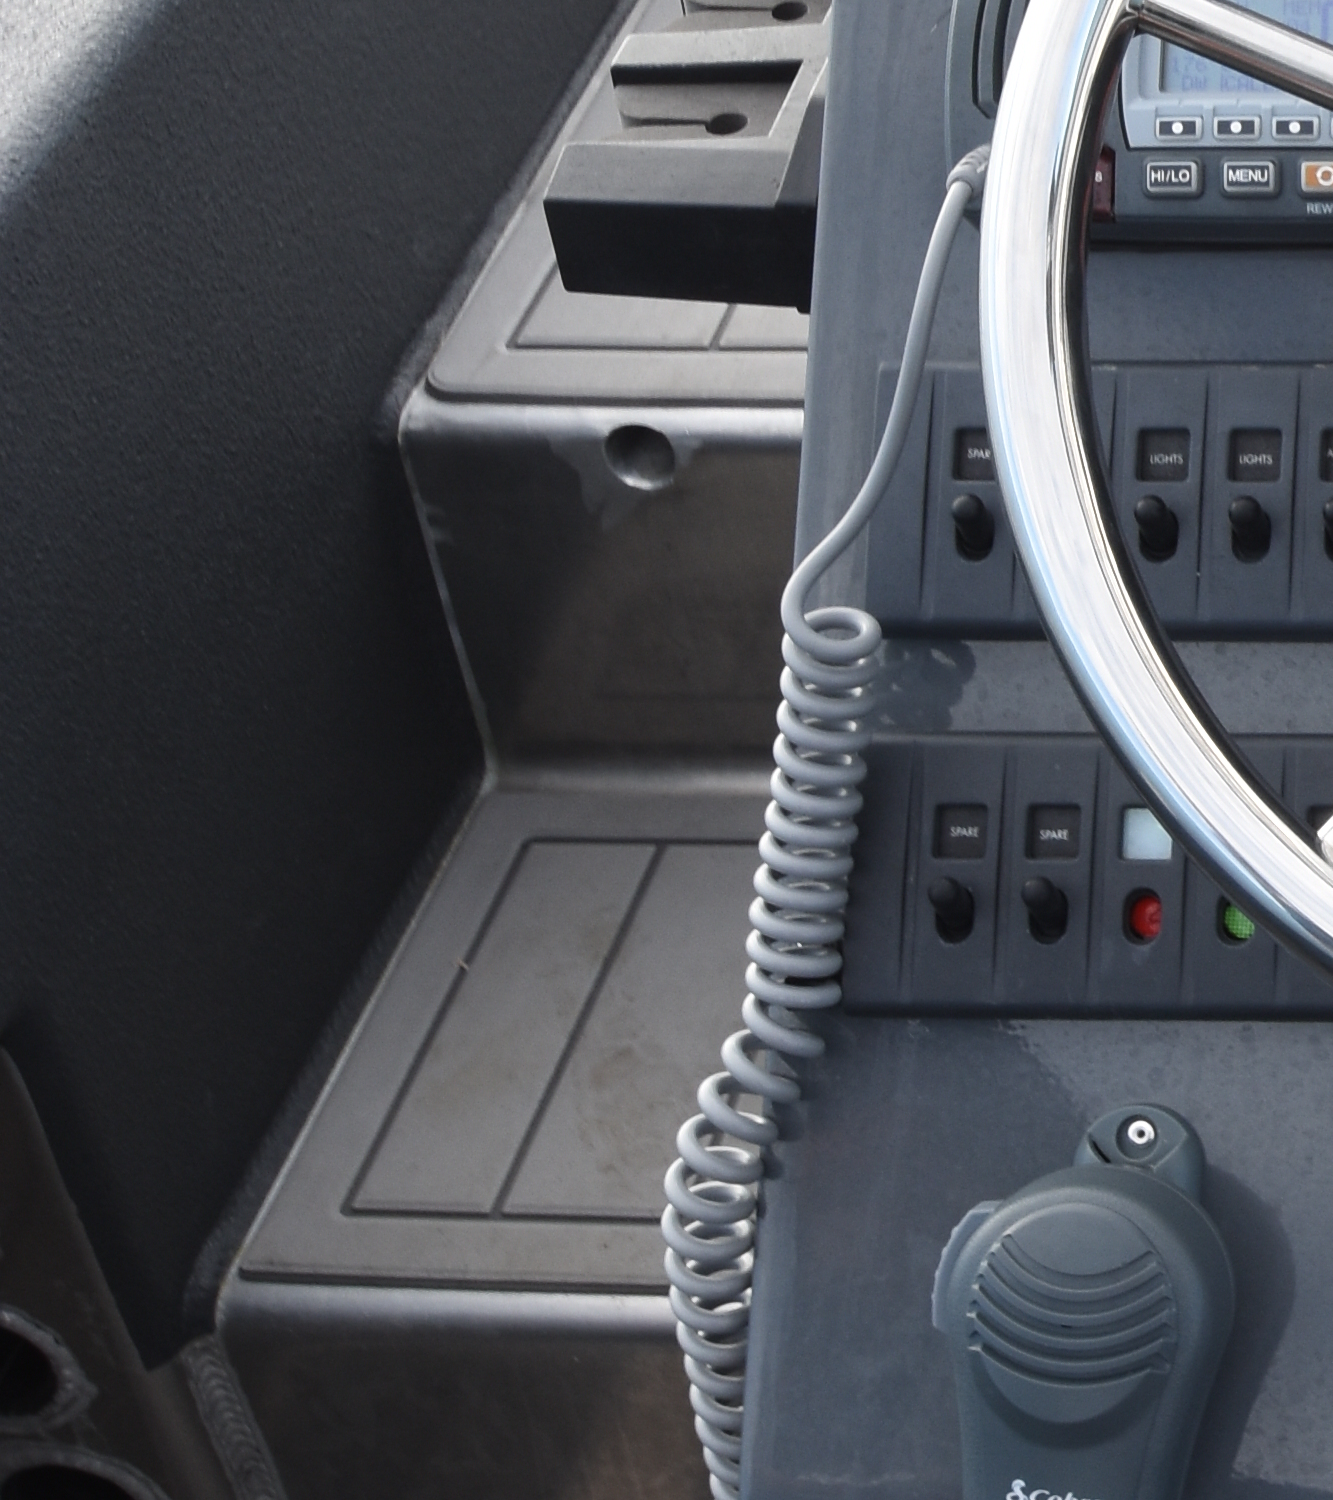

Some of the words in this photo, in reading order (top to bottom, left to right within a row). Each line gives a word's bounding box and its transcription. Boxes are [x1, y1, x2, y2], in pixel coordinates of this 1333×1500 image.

[1151, 169, 1190, 184] HI/LO
[1228, 169, 1267, 183] MENU
[967, 447, 992, 460] SPAR
[1150, 453, 1184, 466] LIGHTS
[1239, 453, 1273, 466] LIGHTS
[950, 826, 980, 838] SPARE
[1040, 828, 1069, 841] SPARE
